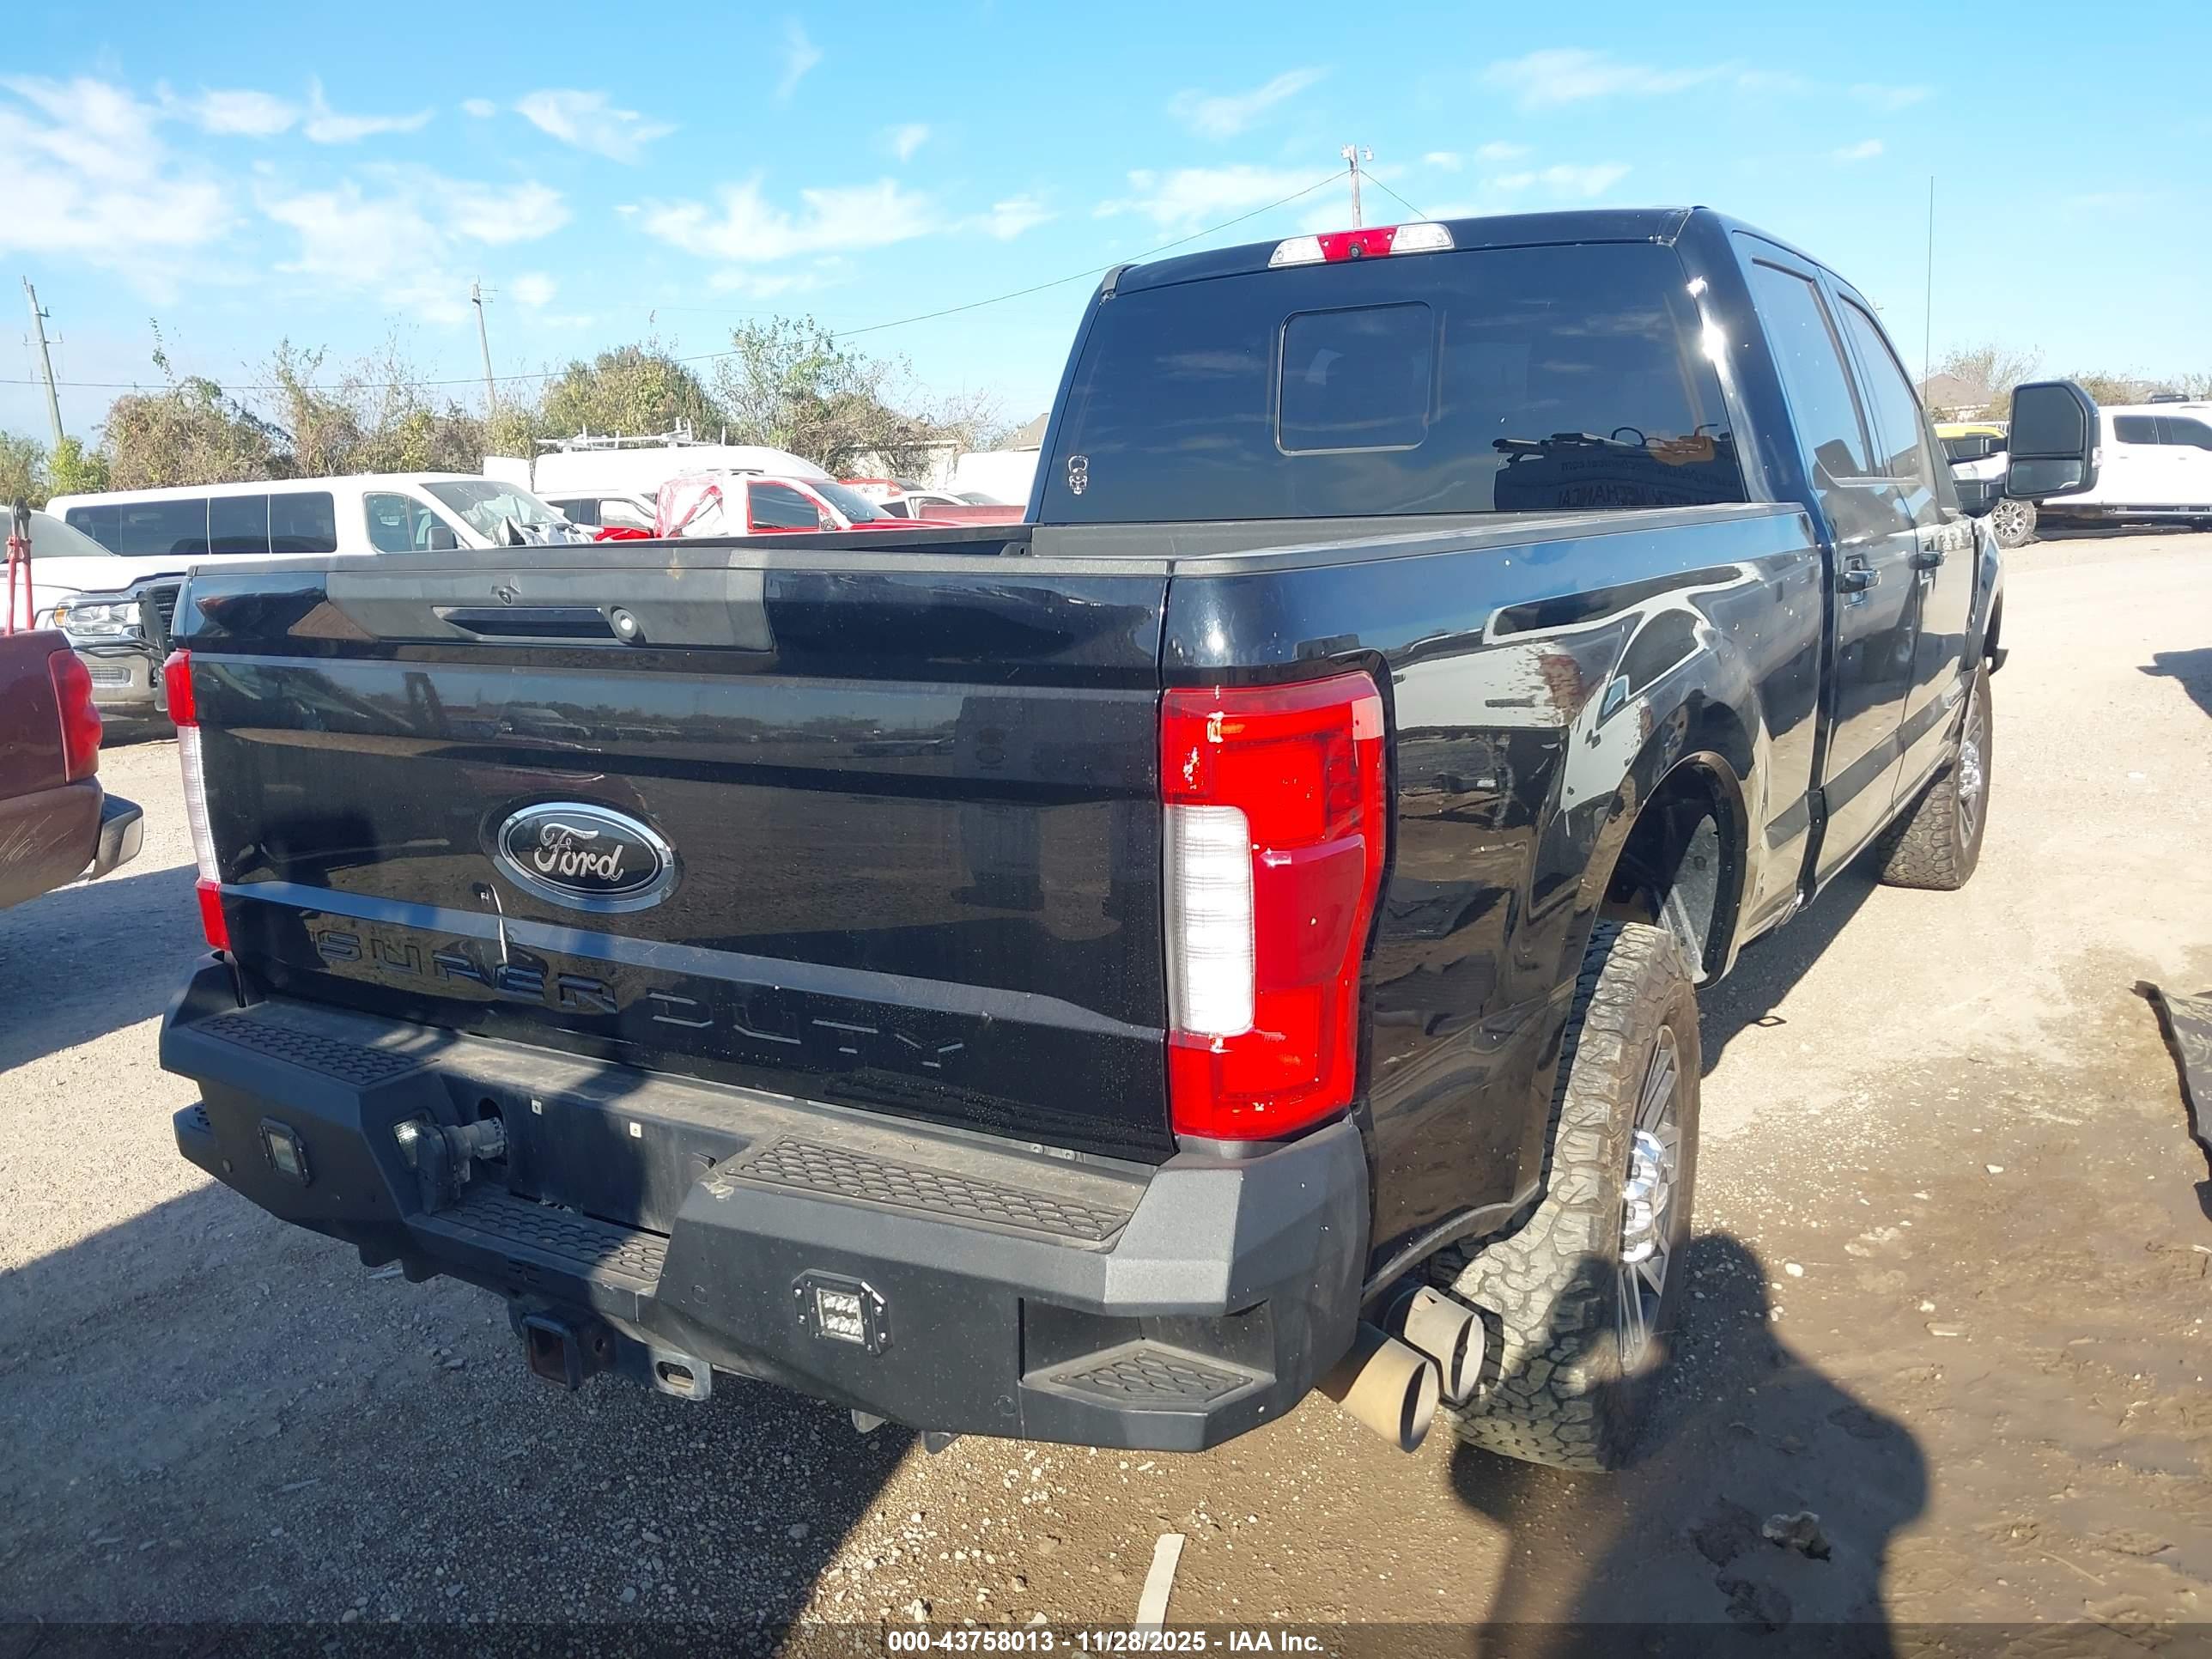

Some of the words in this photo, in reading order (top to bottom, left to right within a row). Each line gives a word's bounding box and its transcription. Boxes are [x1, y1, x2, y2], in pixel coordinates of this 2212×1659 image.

[533, 822, 624, 882] Ford
[318, 927, 620, 1015] SUPER
[646, 986, 965, 1069] DUTY
